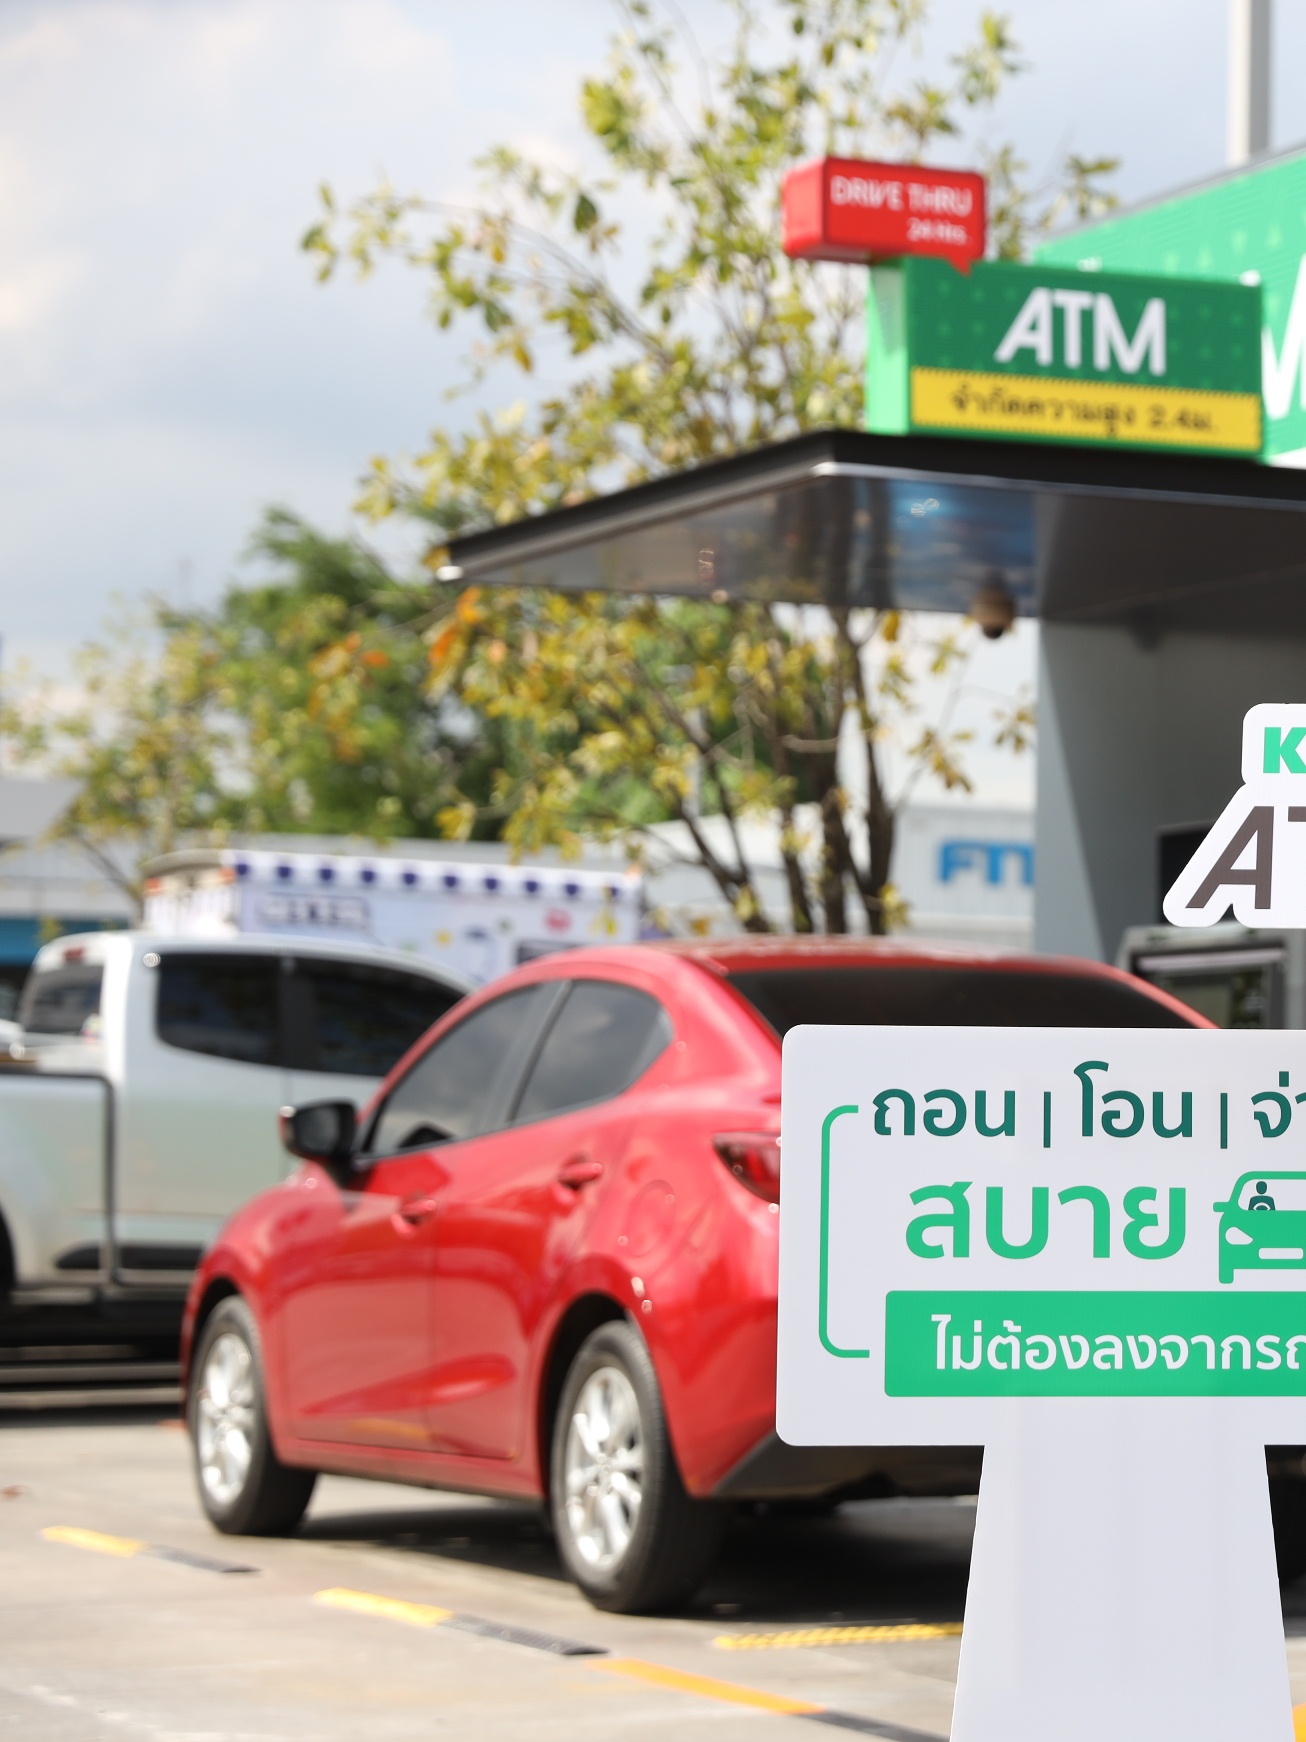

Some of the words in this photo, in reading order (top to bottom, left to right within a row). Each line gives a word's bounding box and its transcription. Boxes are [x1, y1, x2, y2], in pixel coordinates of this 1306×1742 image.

[830, 175, 903, 211] DRIVE
[907, 182, 973, 217] THRU
[994, 287, 1166, 376] ATM
[872, 1088, 1016, 1137] ถอน
[1073, 1061, 1193, 1138] โอน
[905, 1181, 1187, 1261] สบาย
